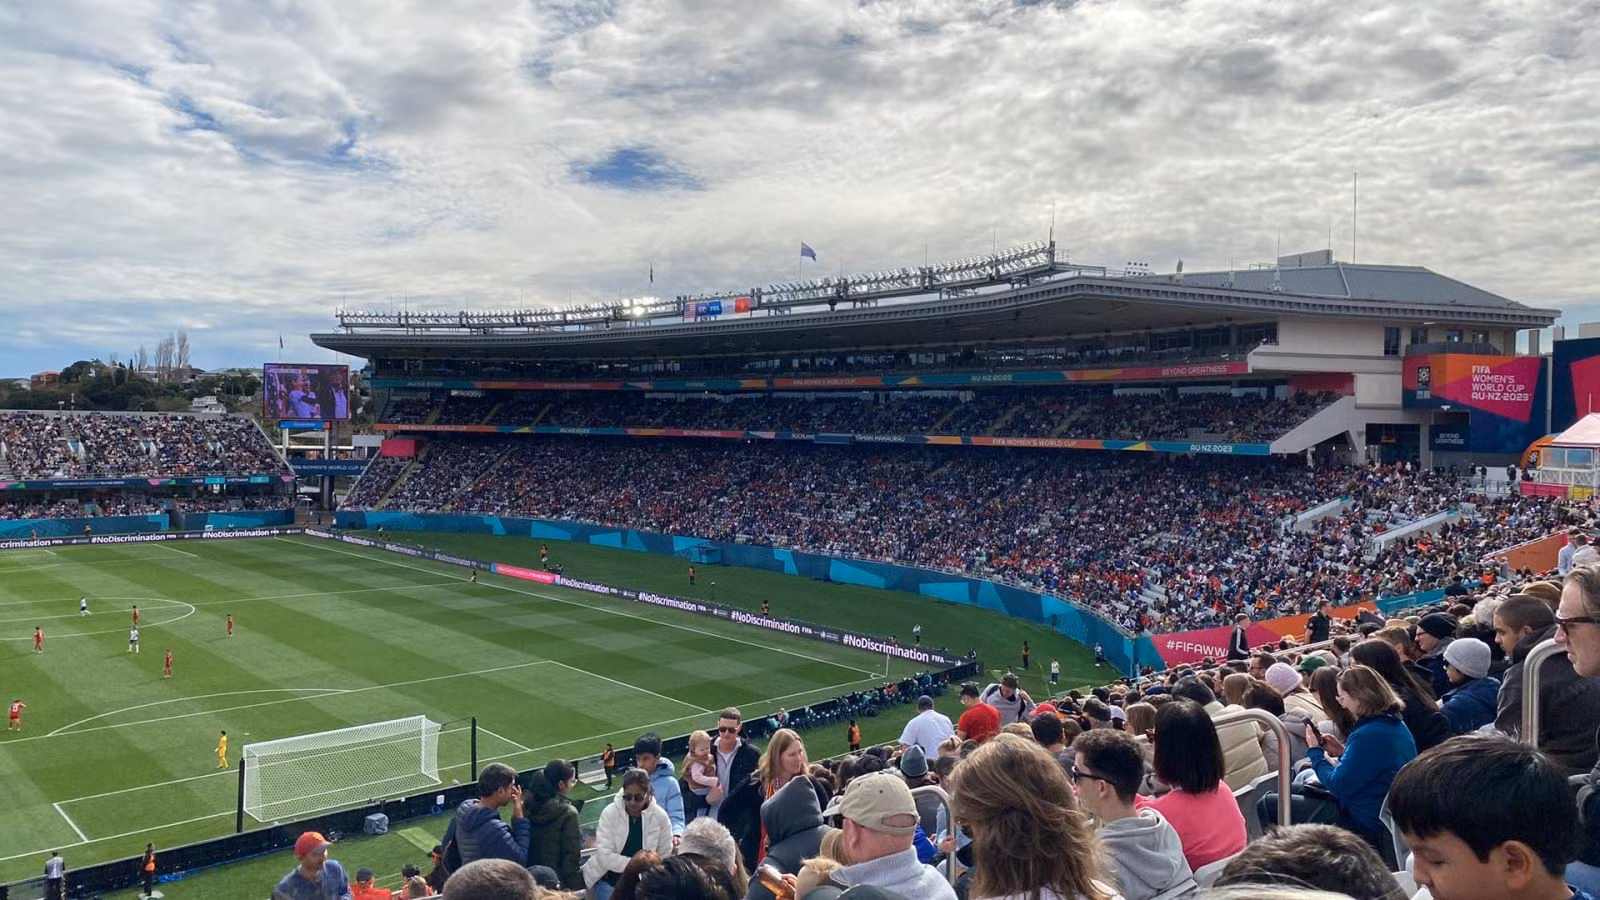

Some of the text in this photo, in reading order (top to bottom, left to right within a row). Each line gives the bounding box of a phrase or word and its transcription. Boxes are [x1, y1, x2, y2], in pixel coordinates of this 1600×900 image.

[1188, 365, 1228, 375] GREATNESS
[1472, 366, 1490, 374] FIFA
[1472, 374, 1515, 383] WOMEN'S
[1472, 383, 1525, 393] WORLD CUP
[1039, 439, 1063, 447] WORLD
[91, 533, 166, 544] #NoDiscrimination
[202, 529, 270, 539] #NoDiscrimination
[560, 577, 610, 594] #NoDiscrimination
[638, 592, 697, 612] #NoDiscrimination
[731, 610, 800, 634] #NoDiscrimination
[843, 634, 929, 662] #NoDiscrimination
[931, 654, 945, 664] FIFA
